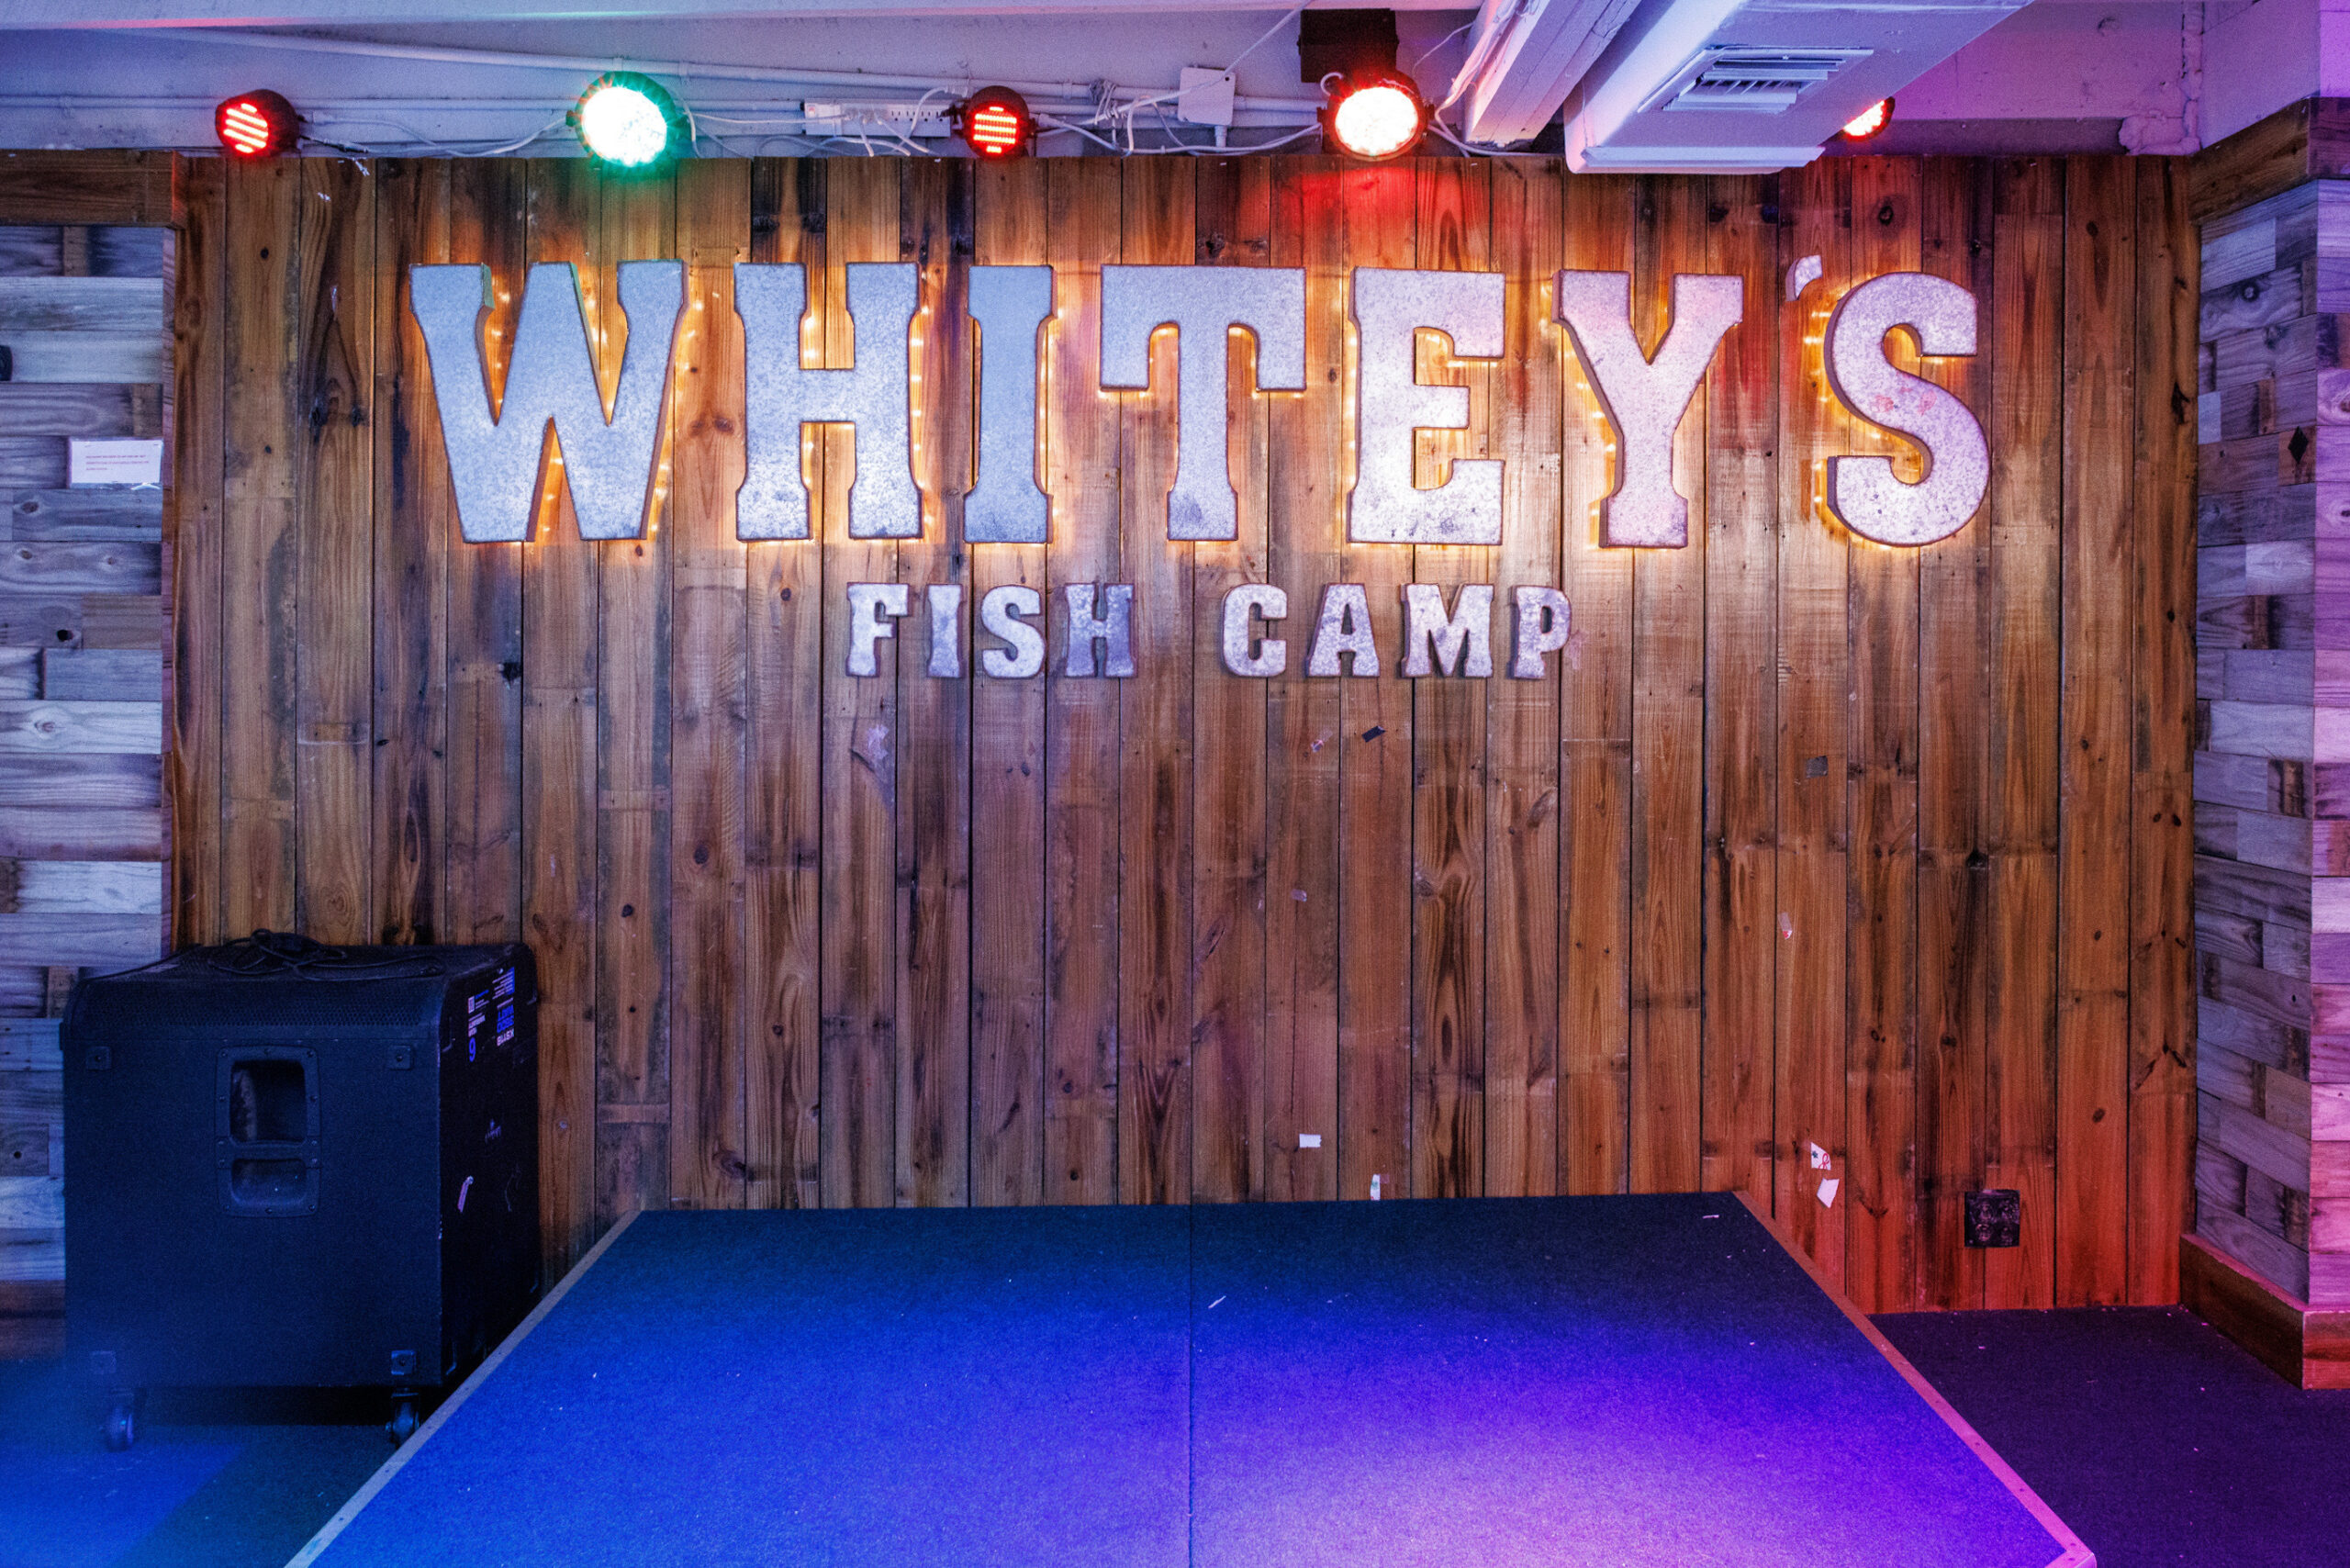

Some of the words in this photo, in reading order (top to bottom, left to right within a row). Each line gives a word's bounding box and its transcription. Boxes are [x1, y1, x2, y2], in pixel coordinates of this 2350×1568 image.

[409, 255, 1990, 547] WHITEY'S
[845, 582, 1137, 678] FISH
[1222, 583, 1572, 680] CAMP
